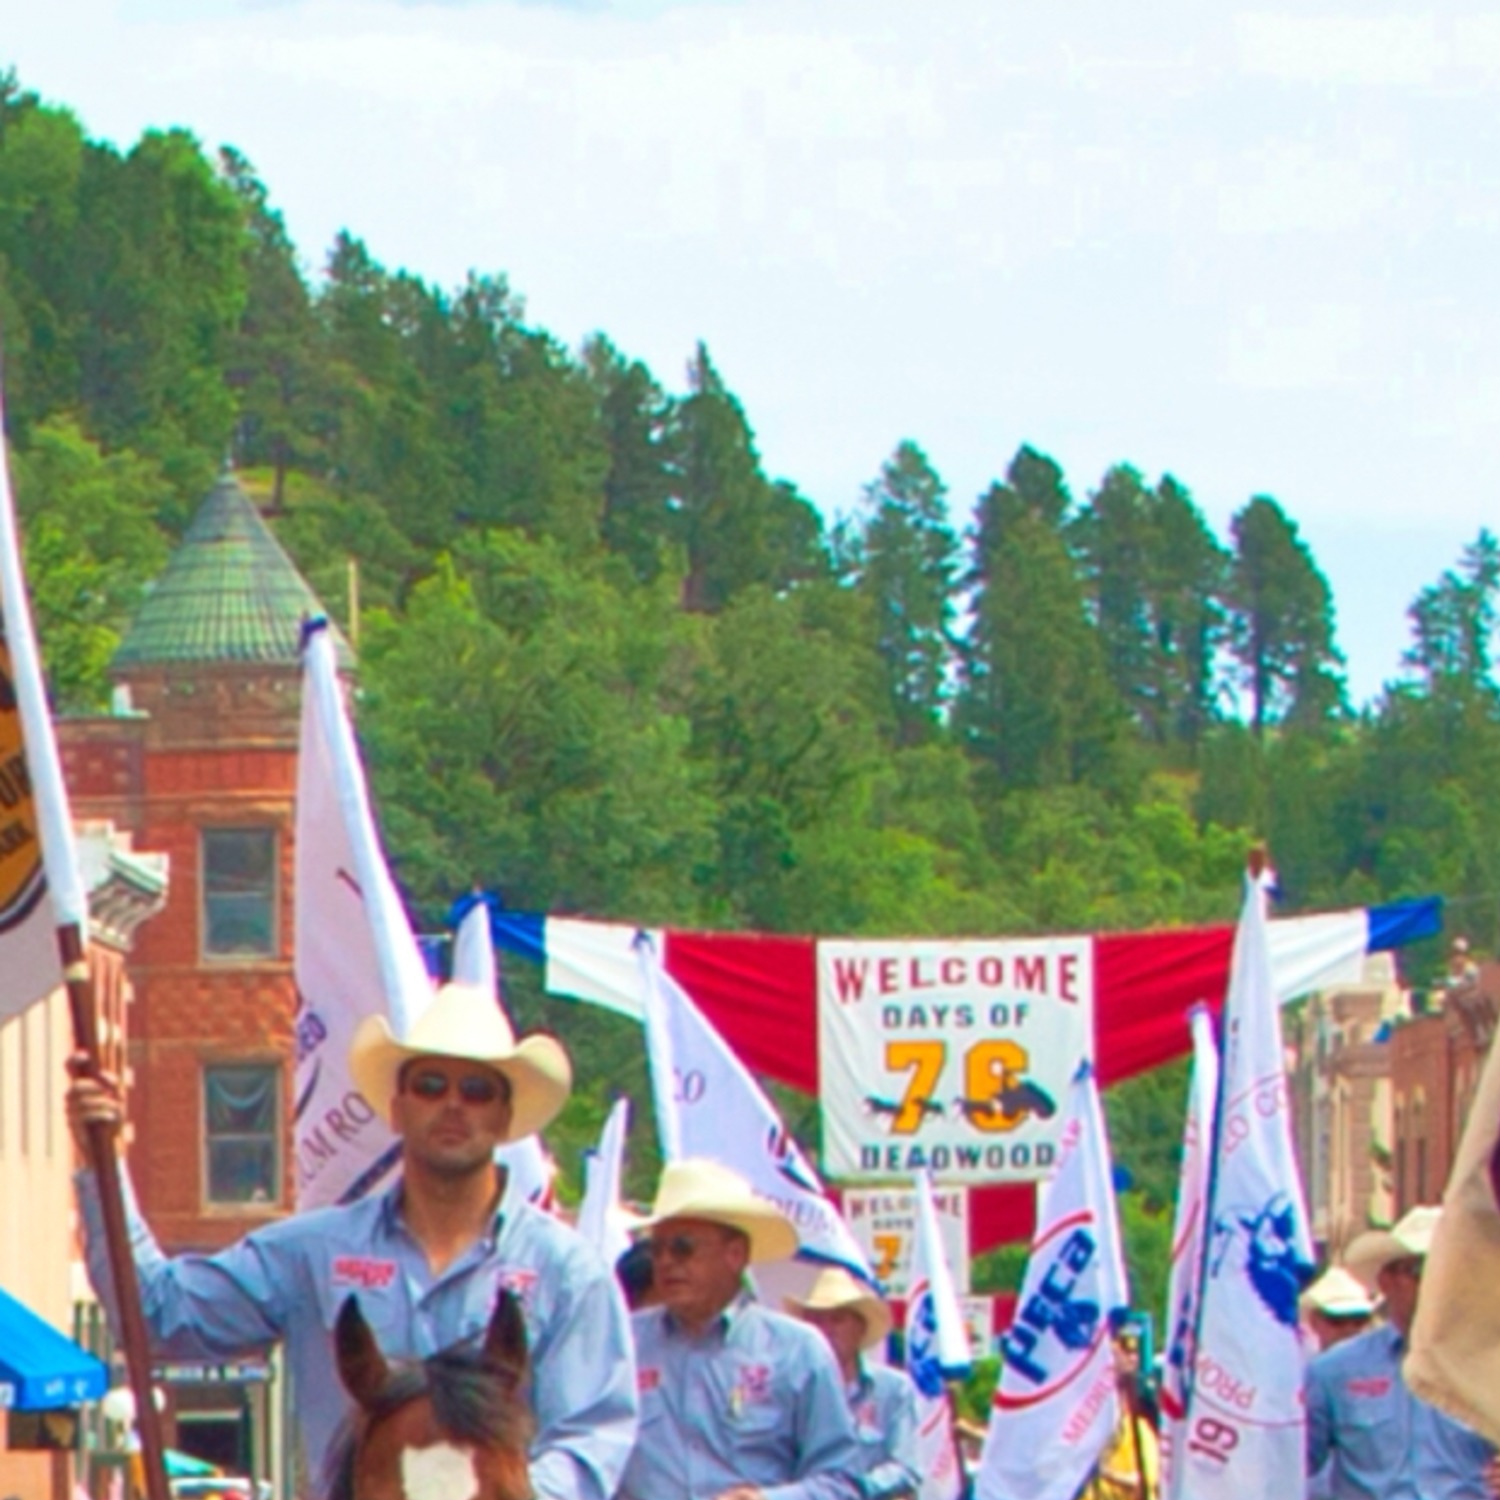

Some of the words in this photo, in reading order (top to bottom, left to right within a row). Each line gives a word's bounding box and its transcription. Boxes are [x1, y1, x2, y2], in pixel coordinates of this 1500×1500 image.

[833, 954, 1079, 1004] WELCOME
[882, 1004, 974, 1029] DAYS
[990, 1002, 1029, 1028] OF
[860, 1143, 1055, 1171] DEADWOOD
[872, 1234, 902, 1280] 7
